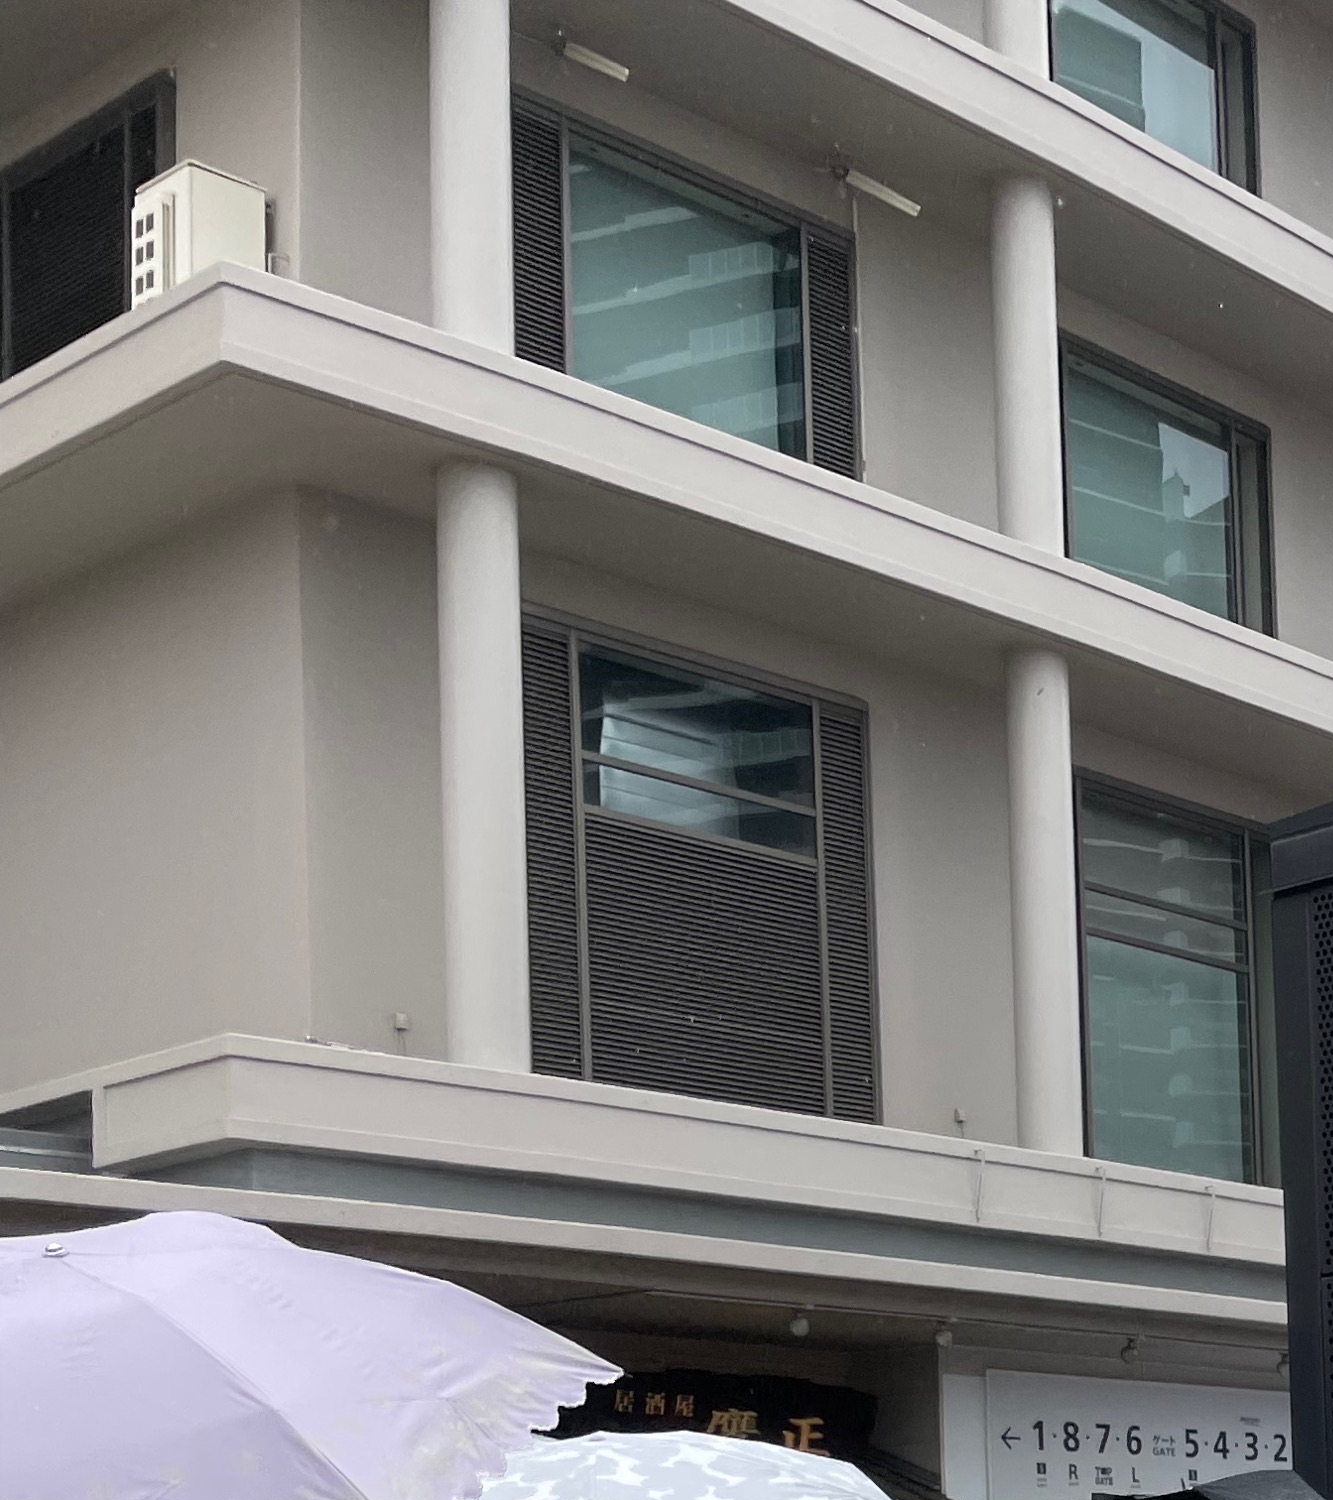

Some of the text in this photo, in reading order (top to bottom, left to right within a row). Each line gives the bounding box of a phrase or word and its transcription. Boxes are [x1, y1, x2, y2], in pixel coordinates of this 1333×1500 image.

[614, 1389, 694, 1417] 居酒屋
[1153, 1435, 1176, 1446] ゲート
[1153, 1447, 1176, 1457] GATE
[1069, 1464, 1078, 1480] R
[1132, 1467, 1140, 1483] L
